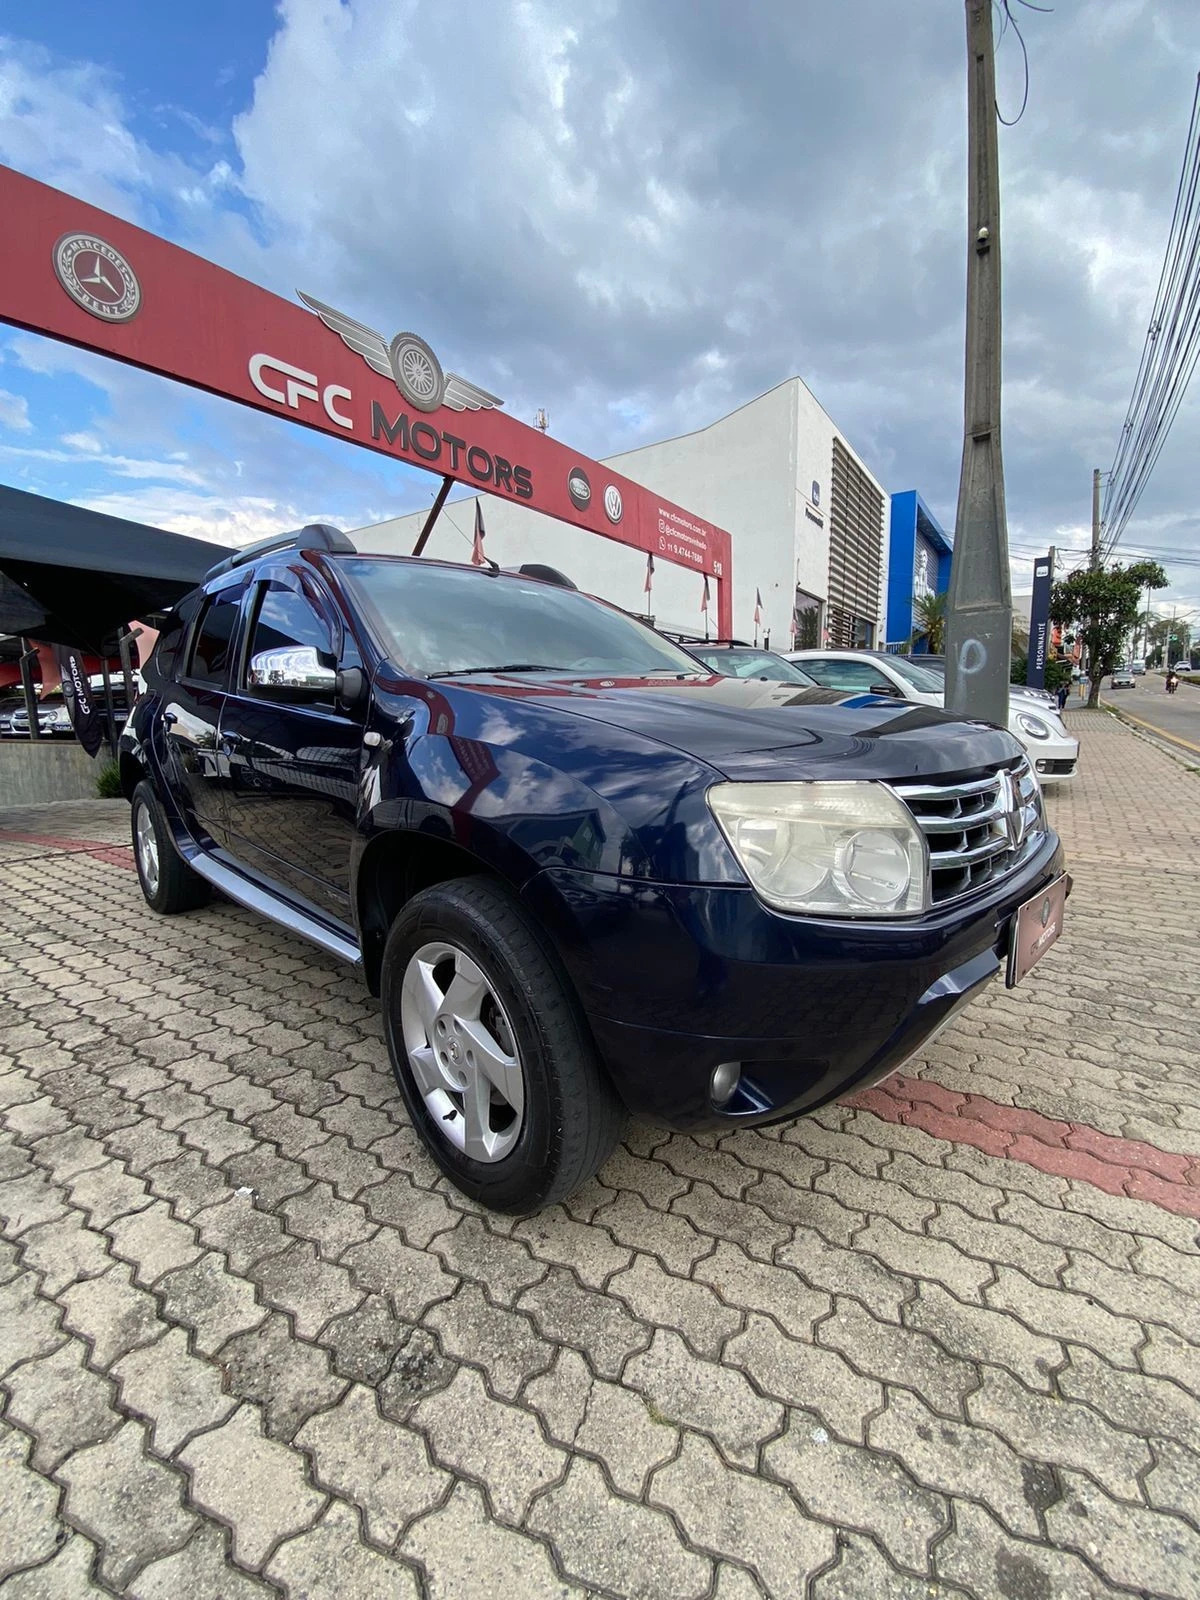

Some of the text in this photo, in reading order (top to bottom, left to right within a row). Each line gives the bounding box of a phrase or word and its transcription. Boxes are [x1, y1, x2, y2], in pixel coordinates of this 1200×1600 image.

[69, 240, 127, 273] MERCEDES
[82, 293, 121, 315] BENZ
[248, 352, 534, 498] CFC MOTORS
